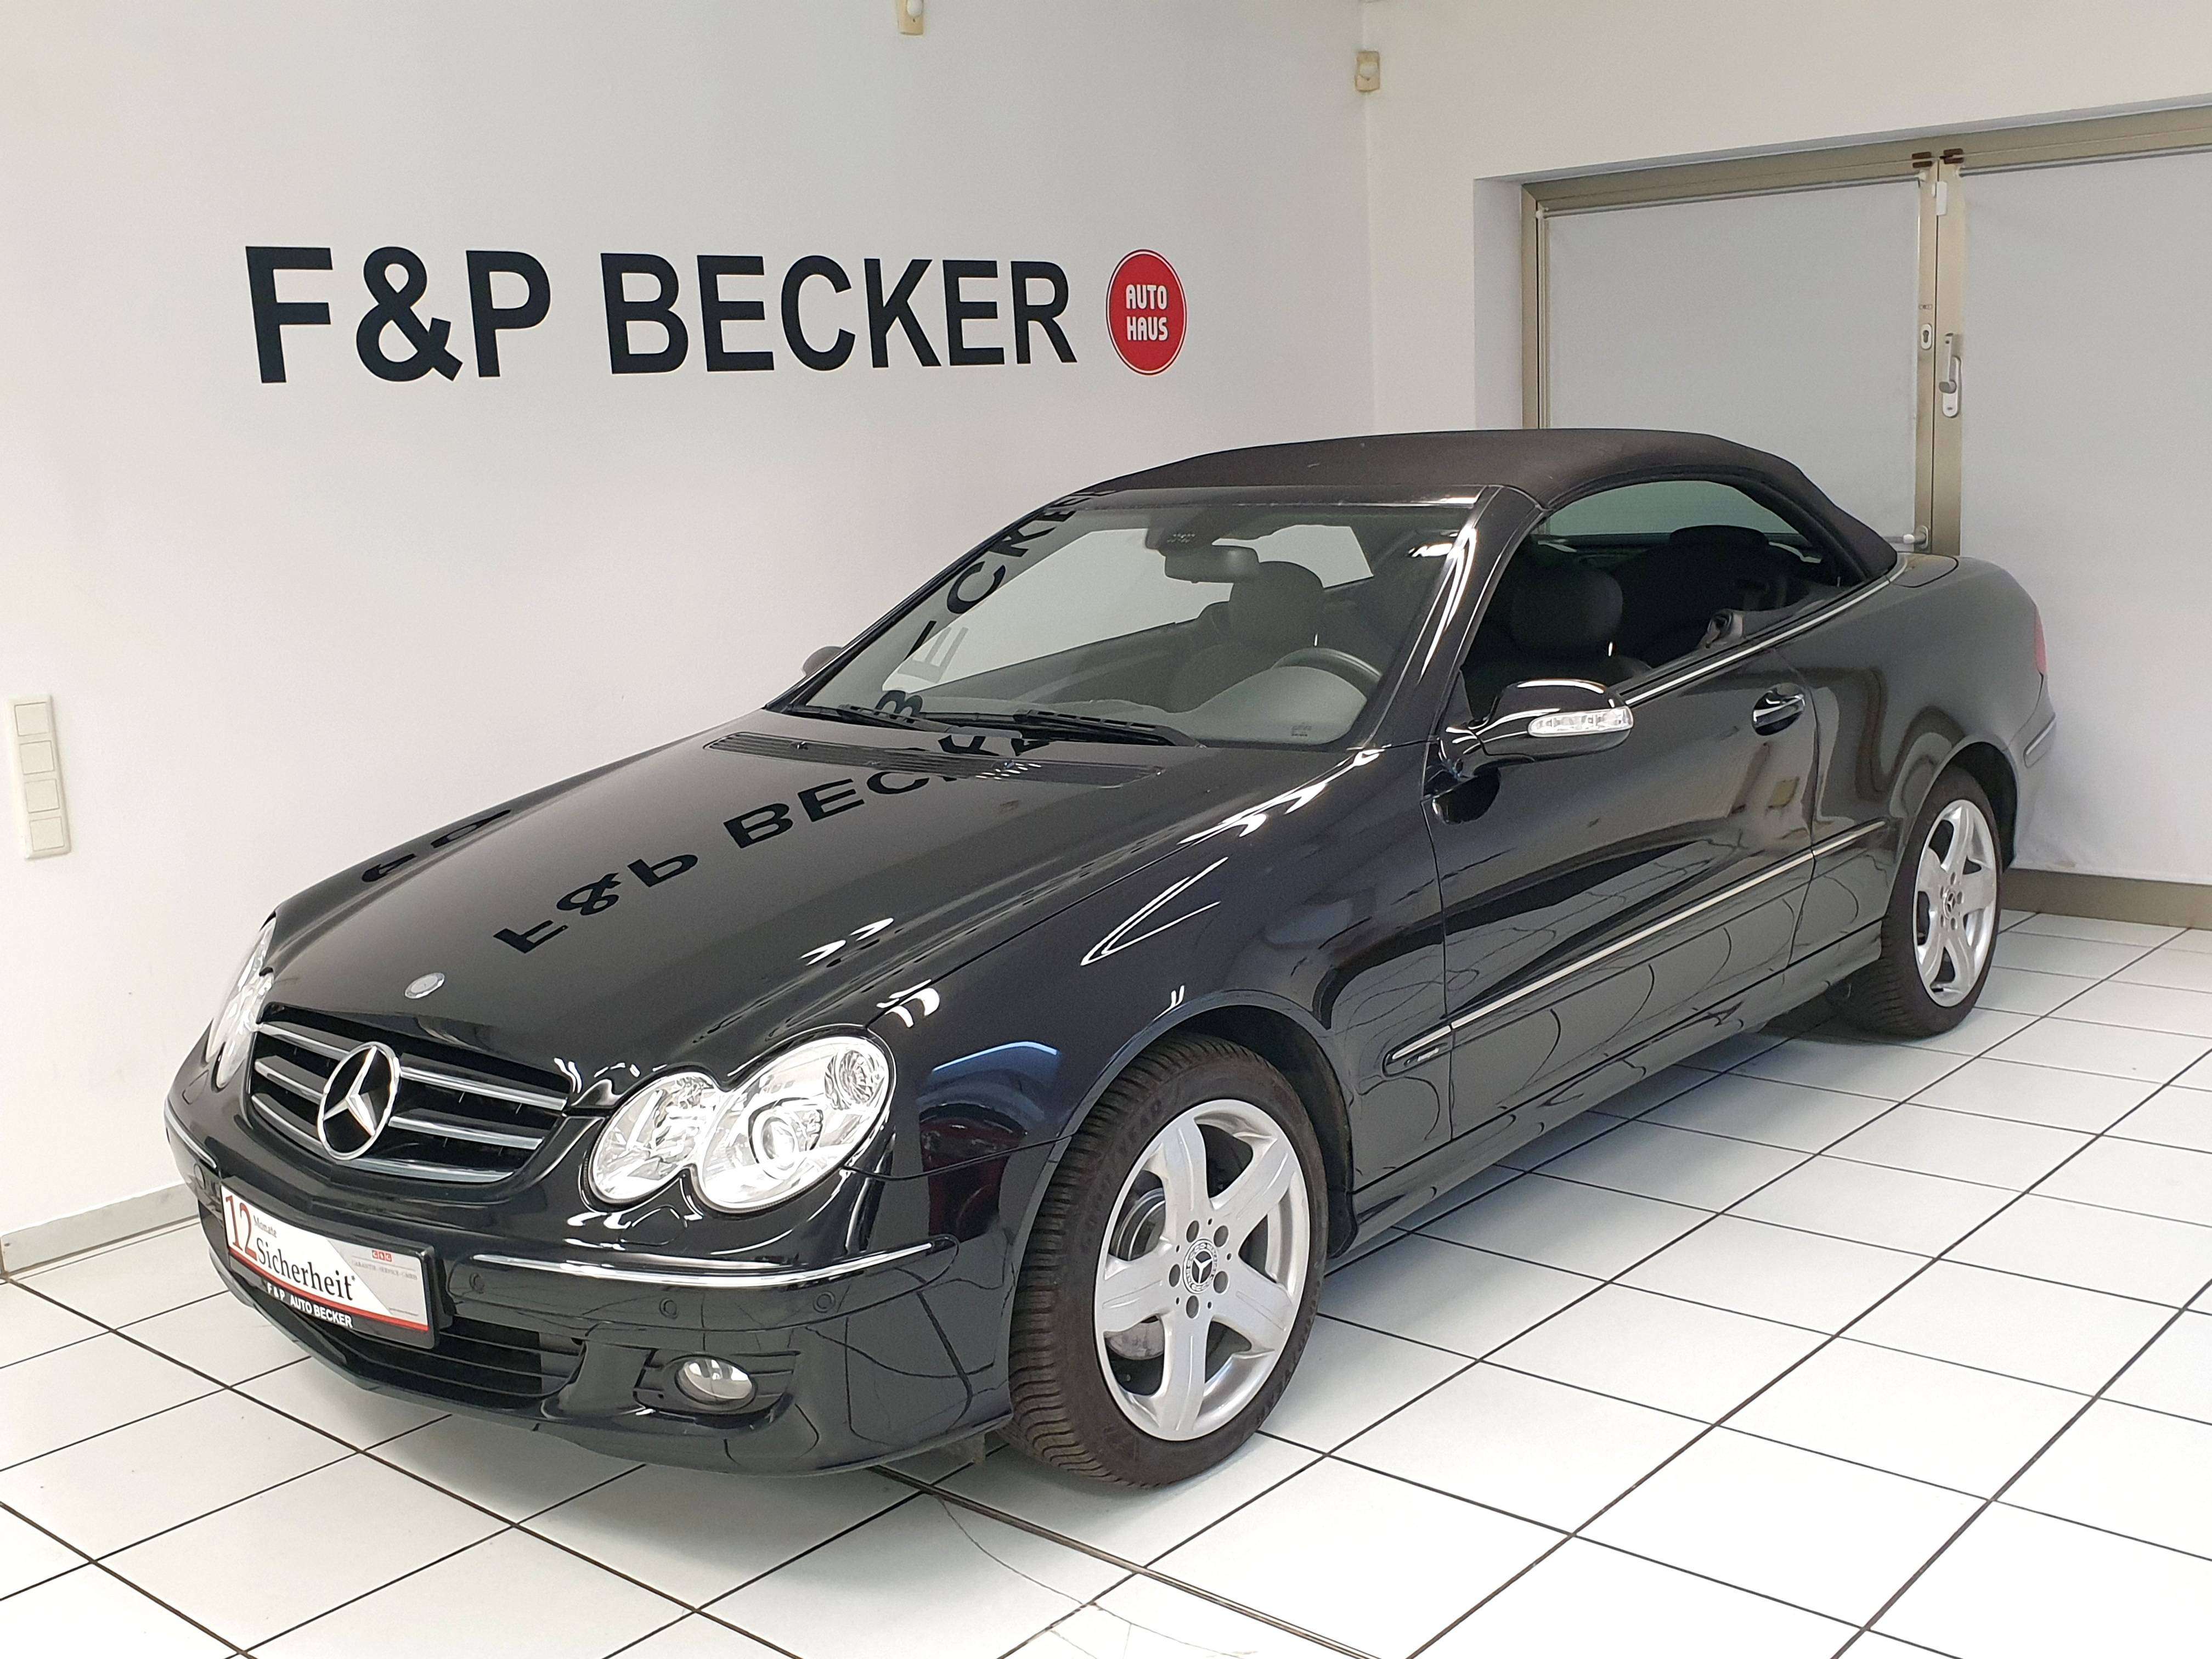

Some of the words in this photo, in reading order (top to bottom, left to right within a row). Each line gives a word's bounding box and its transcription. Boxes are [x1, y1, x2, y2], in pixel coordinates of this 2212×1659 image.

[245, 245, 551, 384] F&P
[600, 252, 1079, 375] BECKER
[1126, 284, 1168, 311] AUTO
[1126, 315, 1169, 341] HAUS
[225, 1195, 257, 1261] 12
[290, 1294, 313, 1314] AUTO
[313, 1304, 353, 1329] BECKER
